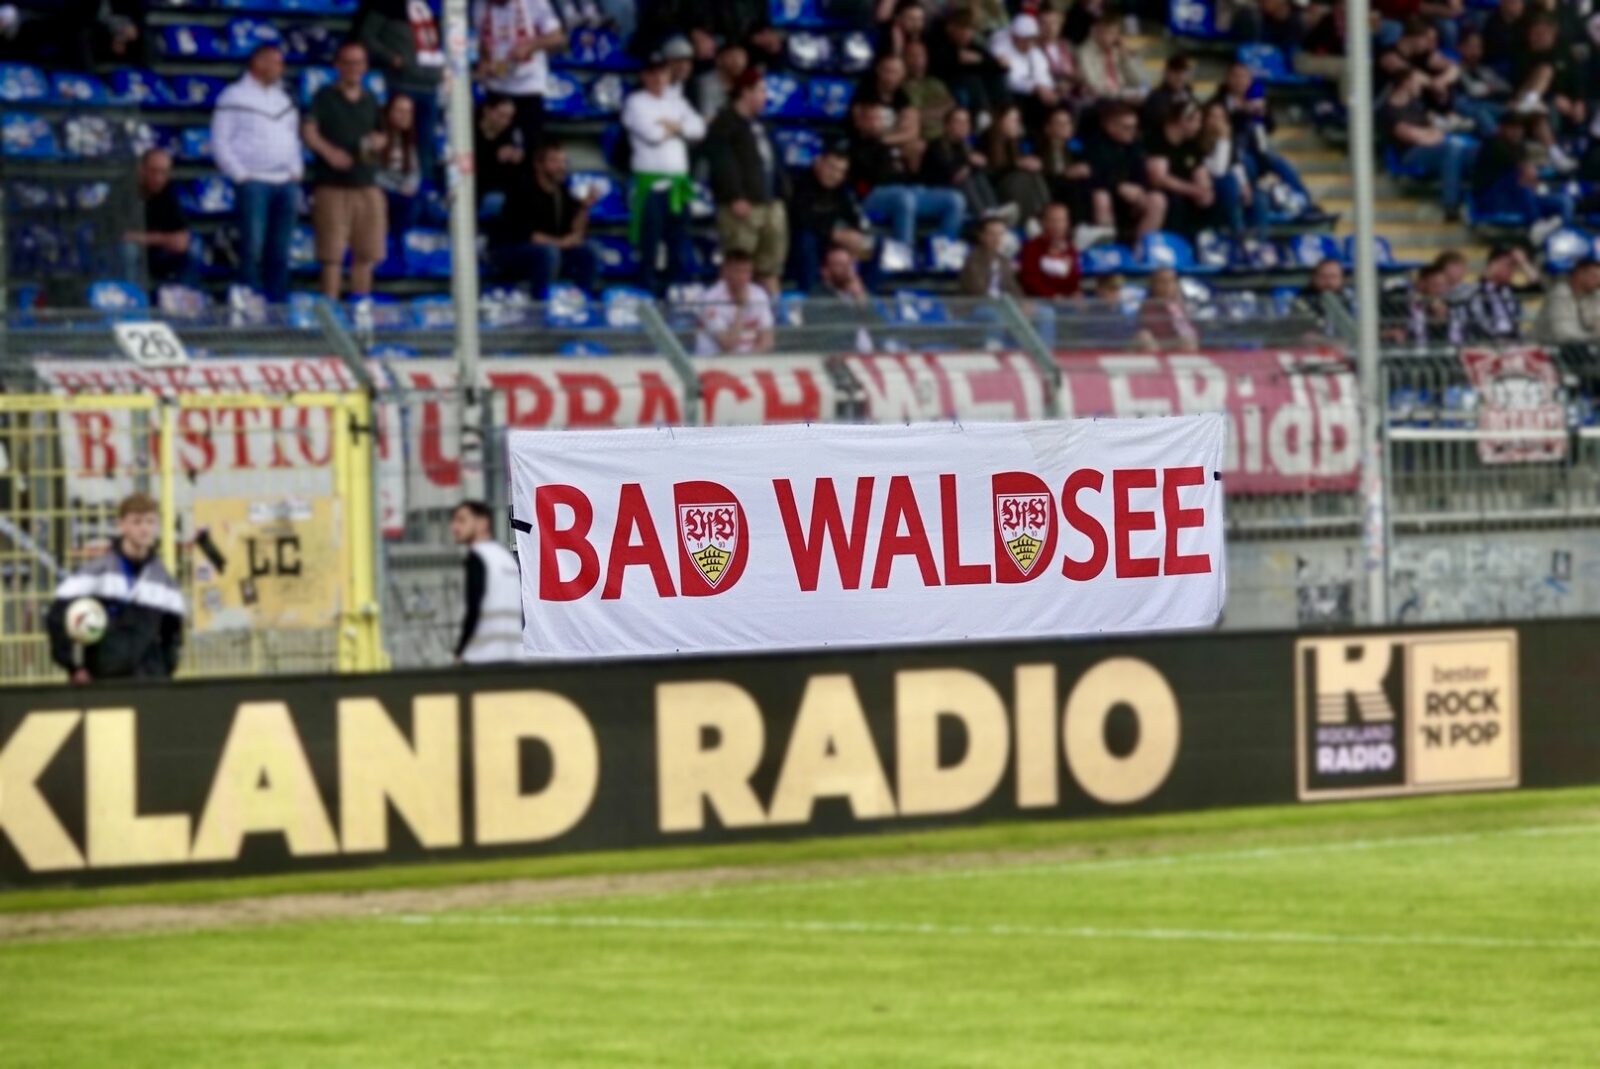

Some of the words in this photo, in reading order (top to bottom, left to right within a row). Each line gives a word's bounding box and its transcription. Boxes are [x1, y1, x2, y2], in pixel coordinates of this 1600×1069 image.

[127, 328, 178, 359] 26
[534, 480, 750, 602] BAD
[772, 466, 1211, 589] WALDSEE
[1432, 664, 1489, 684] bester
[1425, 690, 1500, 717] ROCK
[655, 656, 1181, 833] RADIO
[1316, 723, 1393, 744] ROCKLAND
[1451, 721, 1500, 745] POP
[1316, 745, 1396, 773] RADIO
